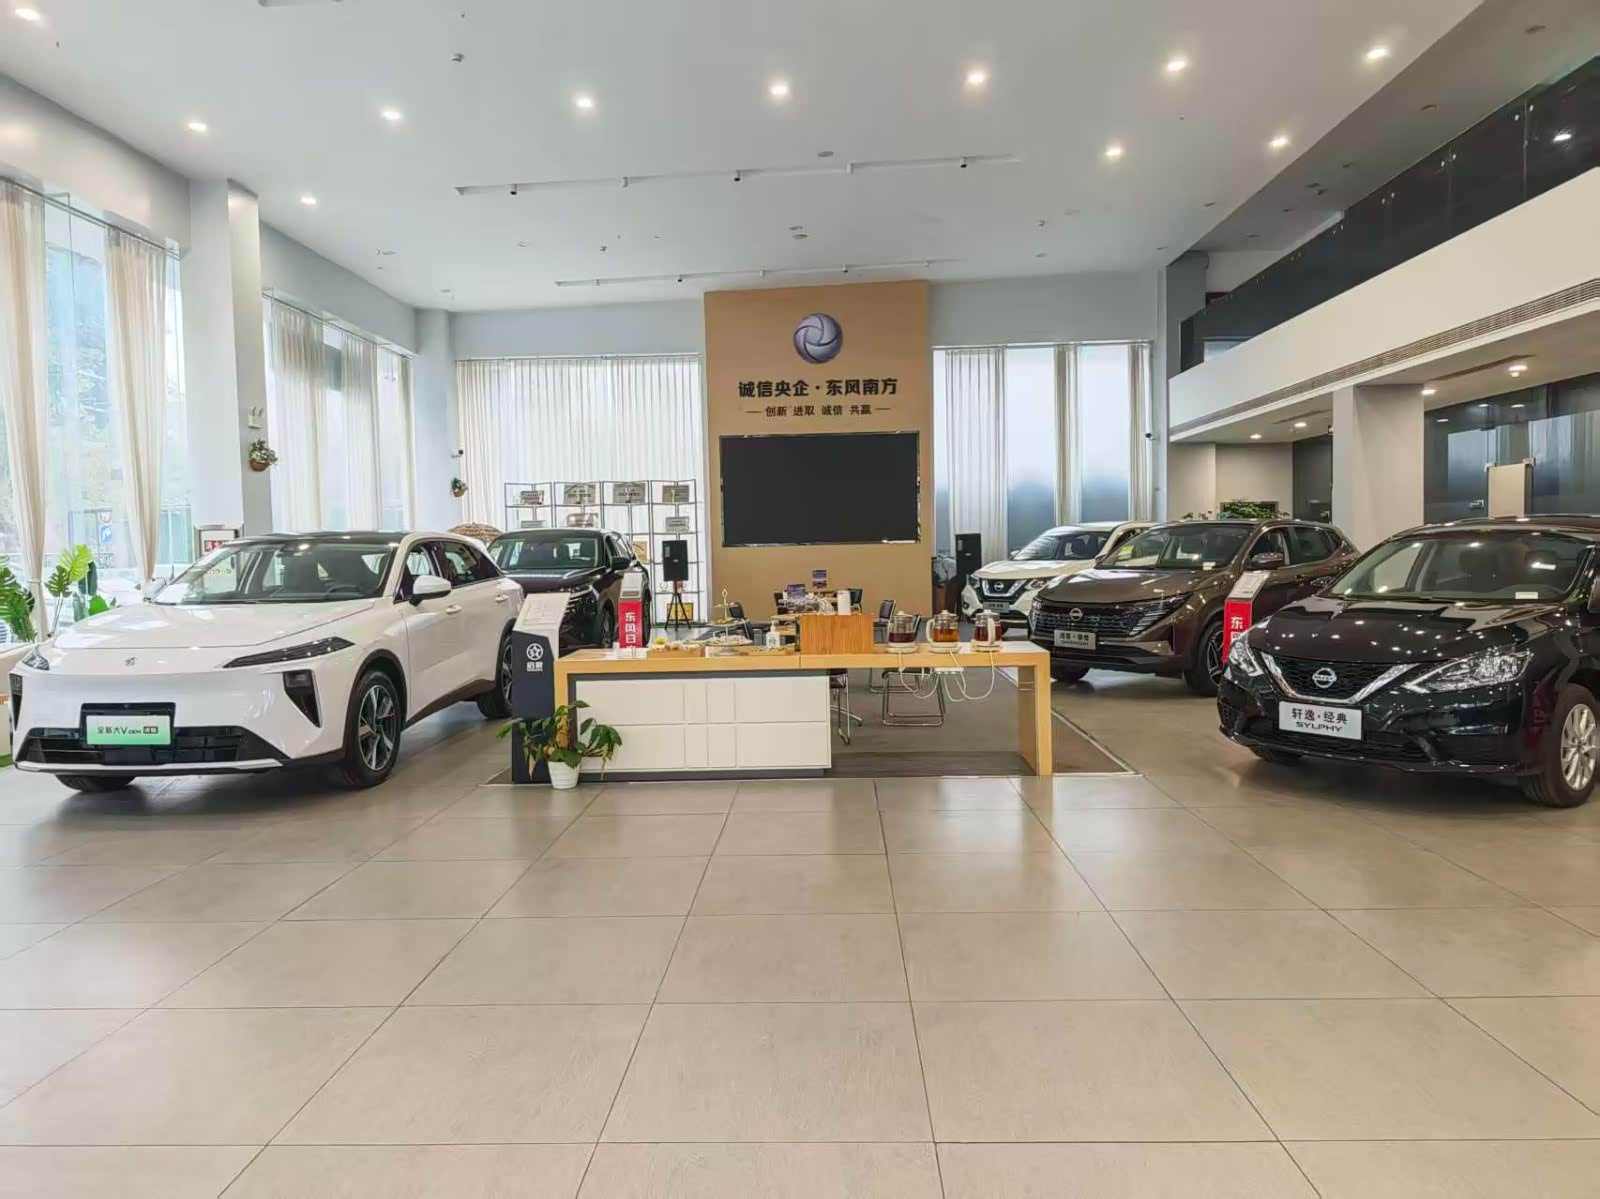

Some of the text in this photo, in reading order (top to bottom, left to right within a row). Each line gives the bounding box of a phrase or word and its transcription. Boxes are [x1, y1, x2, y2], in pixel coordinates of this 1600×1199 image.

[738, 378, 898, 398] 诚信央企·东风南方
[765, 404, 872, 417] 创新 进取 诚信 共赢
[1291, 707, 1348, 725] 轩逸·经典
[1295, 721, 1344, 732] SYLPHY
